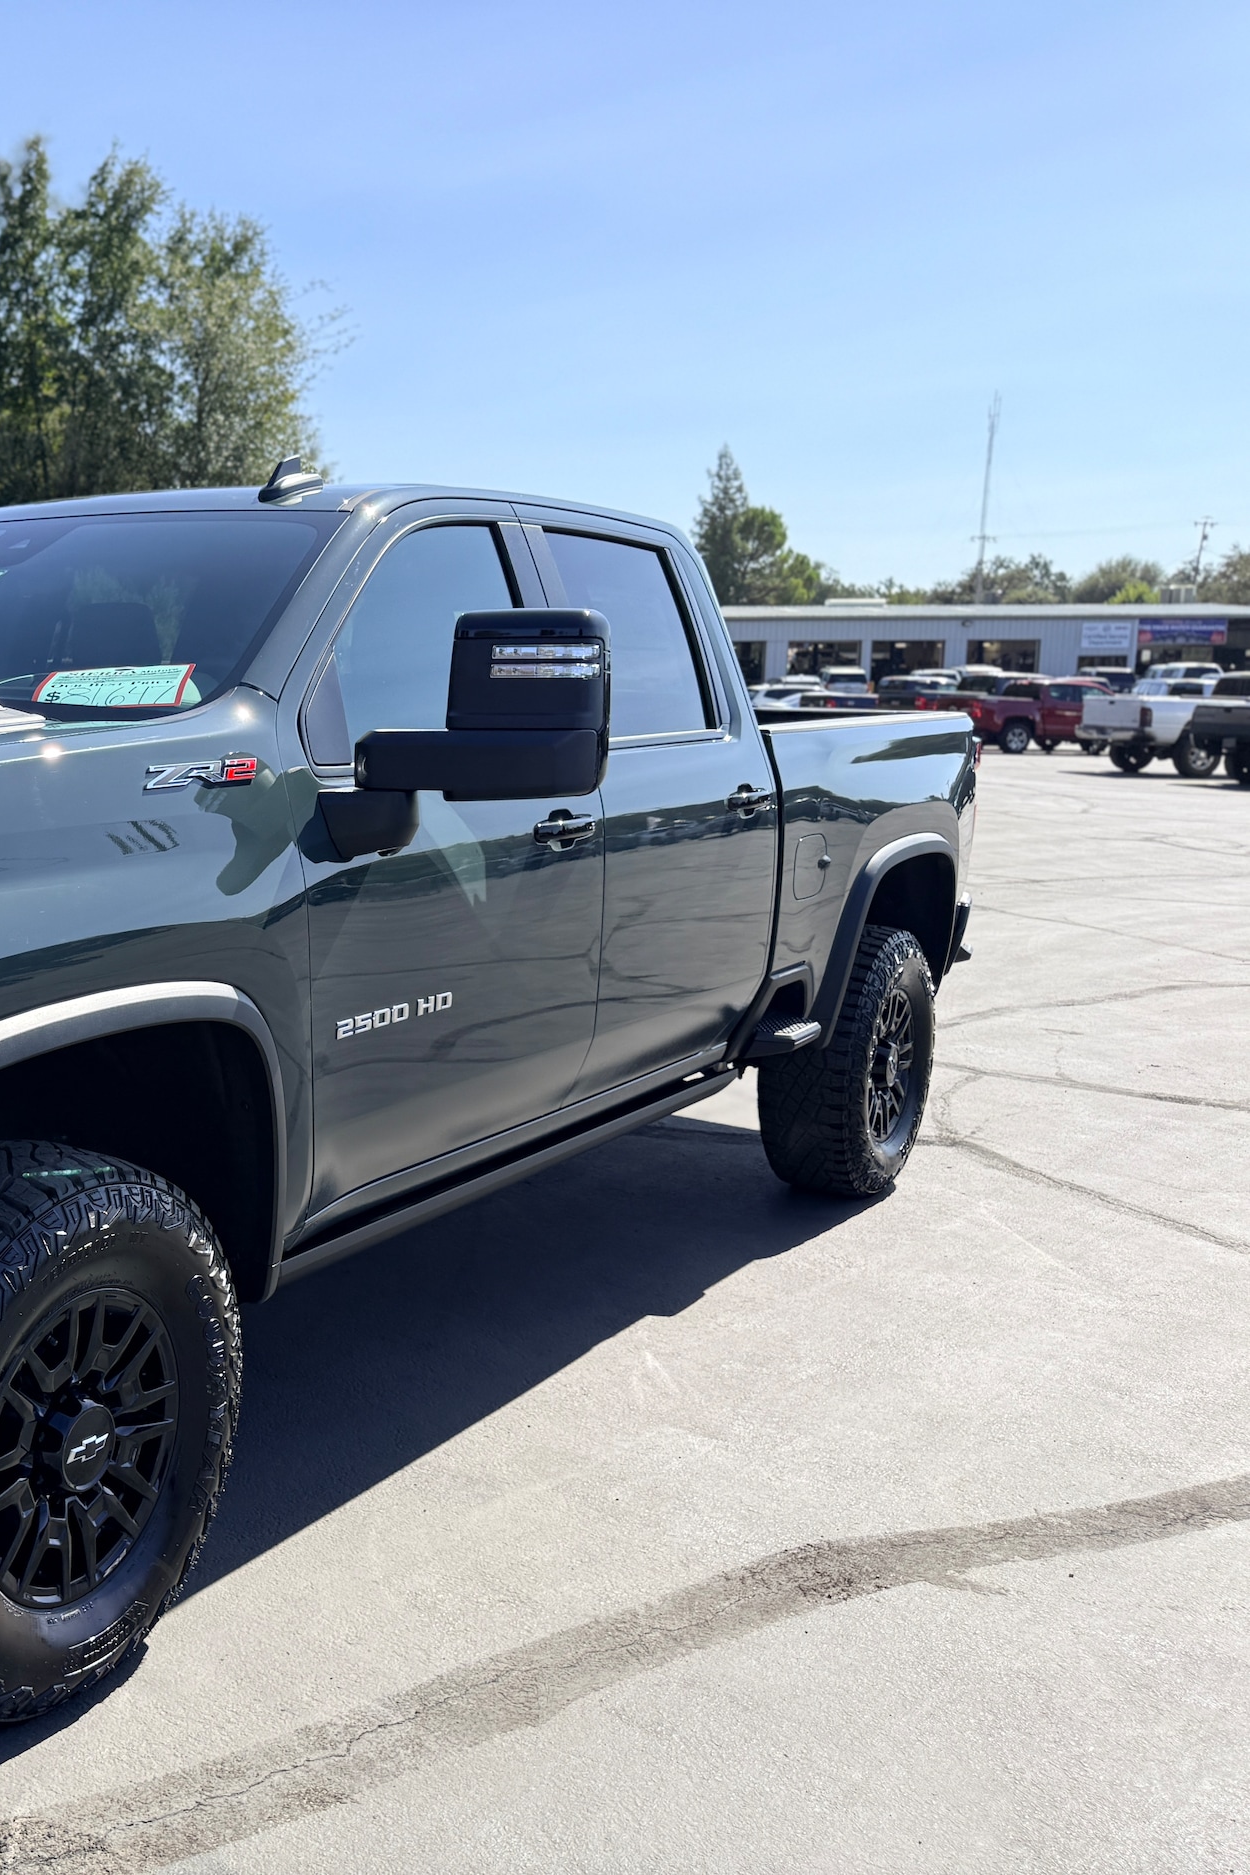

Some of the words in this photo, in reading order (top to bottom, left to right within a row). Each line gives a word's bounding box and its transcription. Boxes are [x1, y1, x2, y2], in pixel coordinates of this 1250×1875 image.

[146, 758, 258, 790] ZR2
[335, 1002, 410, 1041] 2500
[416, 991, 453, 1017] HD
[186, 1273, 227, 1516] GOODYEAR
